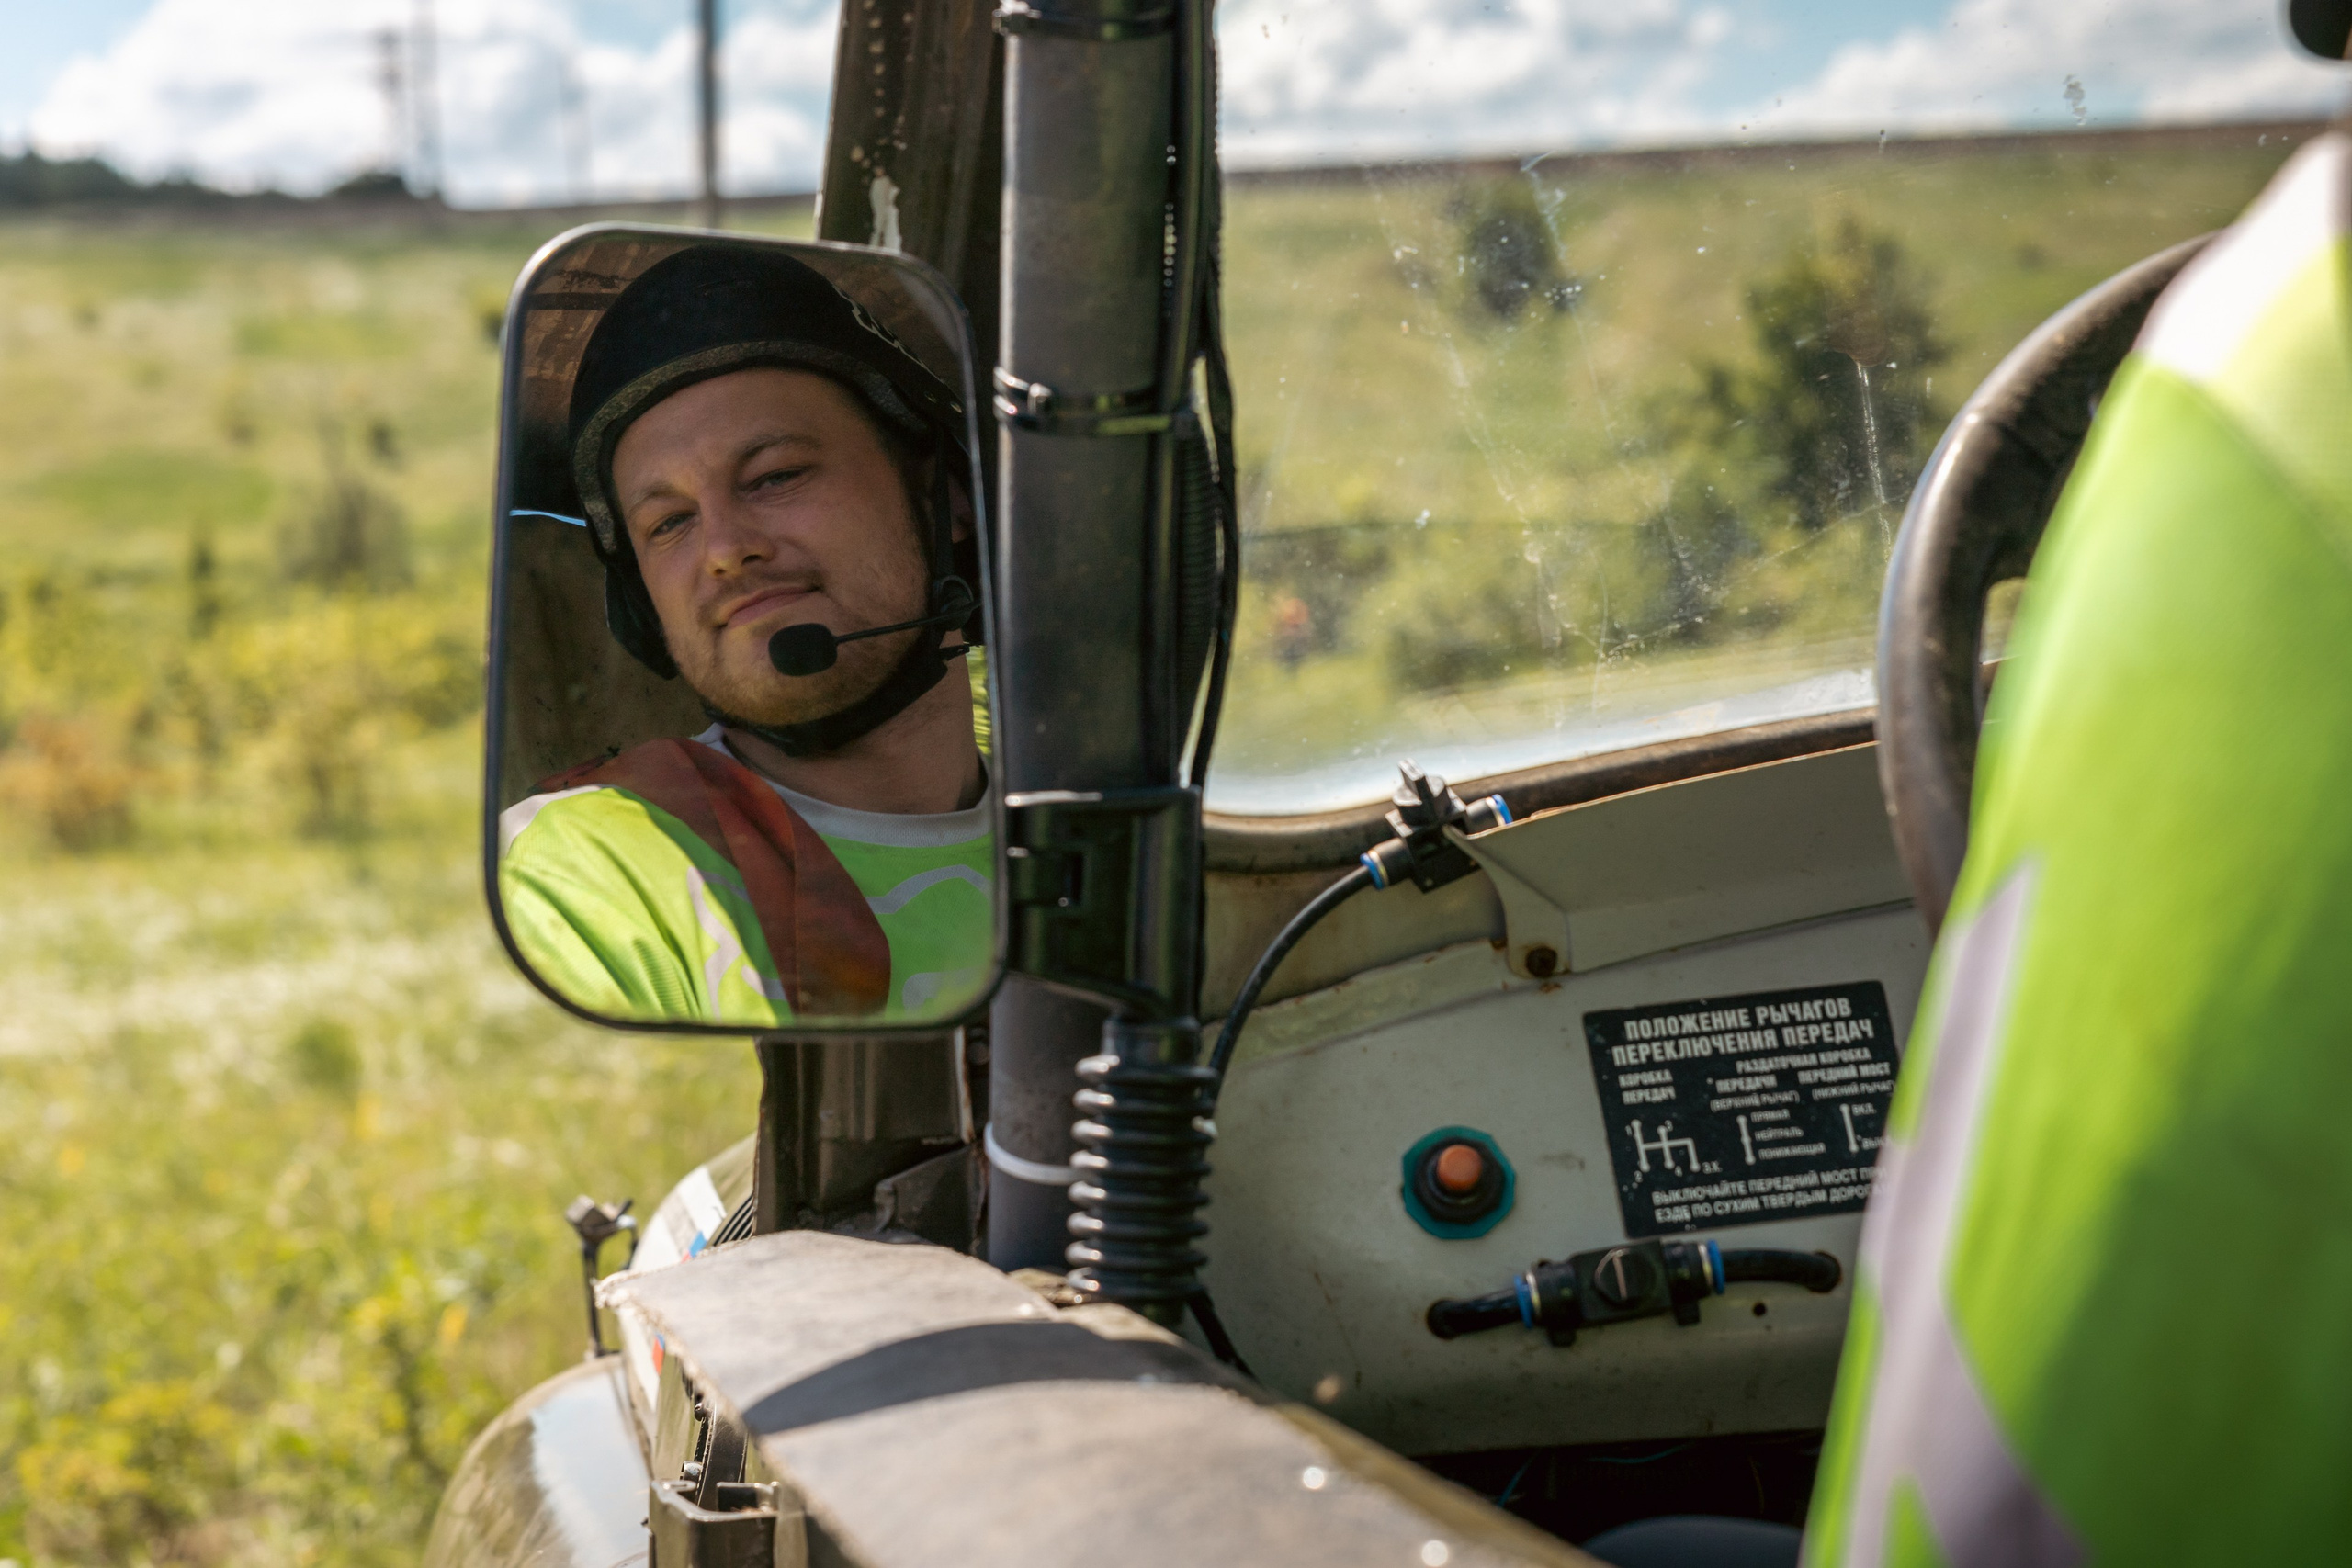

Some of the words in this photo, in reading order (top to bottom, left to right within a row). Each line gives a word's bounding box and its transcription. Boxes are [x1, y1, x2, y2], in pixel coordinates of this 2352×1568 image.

[1624, 1009, 1751, 1041] ПОЛОЖЕНИЕ
[1755, 998, 1852, 1026] РЫЧАГОВ
[1611, 1029, 1779, 1067] ПЕРЕКЛЮЧЕНИЯ
[1781, 1019, 1874, 1047] ПЕРЕДАЧ
[1618, 1069, 1673, 1088] КОРОБКА
[1858, 1062, 1891, 1077] МОСТ
[1622, 1086, 1676, 1105] ПЕРЕДАЧ
[1652, 1180, 1747, 1205] ВЫКЛЮЧАЙТЕ
[1820, 1168, 1858, 1185] МОСТ
[1655, 1205, 1691, 1223] ЕЗДЕ
[1691, 1202, 1713, 1217] ПО
[1713, 1197, 1760, 1215] СУХИМ
[1761, 1189, 1828, 1209] ТВЕРДЫМ
